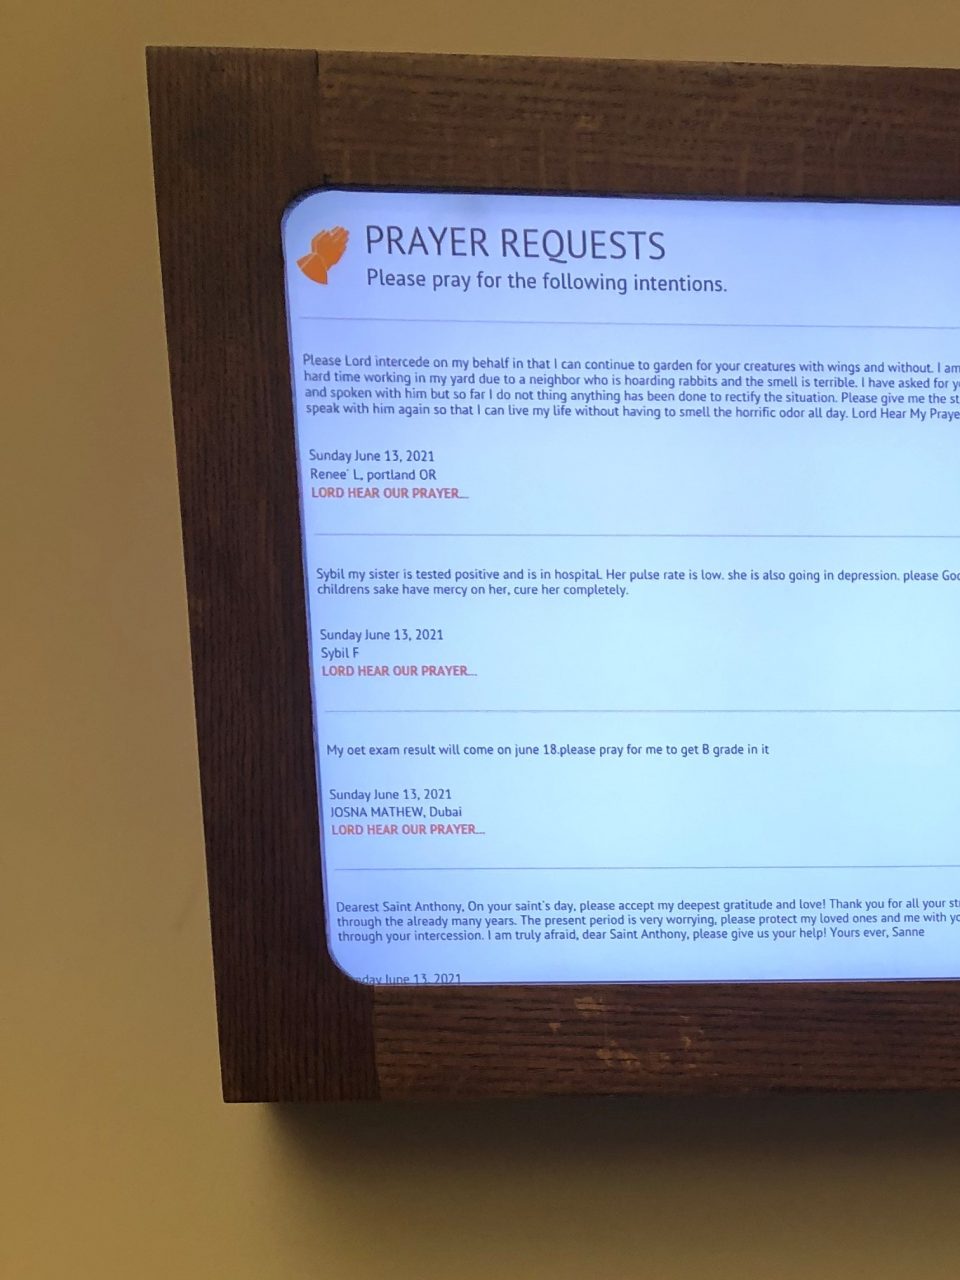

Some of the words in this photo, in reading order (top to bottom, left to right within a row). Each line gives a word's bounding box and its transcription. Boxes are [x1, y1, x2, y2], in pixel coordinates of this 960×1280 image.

[366, 224, 489, 257] PRAYER
[501, 228, 665, 263] REQUESTS
[366, 268, 426, 286] Please
[432, 274, 471, 292] pray
[476, 270, 502, 288] for
[506, 271, 536, 289] the
[542, 271, 627, 295] following
[633, 273, 727, 292] intentions.
[302, 355, 342, 368] Please
[344, 355, 372, 366] Lord
[375, 356, 430, 367] intercede
[432, 358, 448, 368] on
[451, 359, 469, 371] my
[472, 357, 510, 369] behalf
[512, 357, 524, 369] in
[526, 357, 551, 369] that
[554, 357, 558, 369] I
[560, 360, 581, 369] can
[584, 358, 635, 370] continue
[637, 360, 650, 370] to
[652, 359, 693, 374] garden
[696, 359, 713, 371] for
[714, 362, 741, 374] your
[743, 361, 796, 372] creatures
[798, 360, 824, 372] with
[826, 360, 861, 376] wings
[863, 361, 885, 373] and
[886, 361, 934, 373] without.
[937, 361, 941, 373] I
[309, 449, 352, 464] Sunday
[353, 449, 380, 461] June
[384, 449, 403, 463] 13,
[405, 449, 435, 462] 2021
[366, 468, 416, 483] portland
[418, 468, 438, 480] OR
[311, 486, 344, 498] LORD
[347, 486, 380, 498] HEAR
[383, 487, 409, 499] OUR
[316, 583, 370, 595] childrens
[372, 583, 400, 594] sake
[401, 583, 430, 594] have
[432, 586, 468, 597] mercy
[470, 586, 486, 594] on
[488, 583, 511, 596] her,
[512, 586, 539, 595] cure
[540, 584, 560, 595] her
[562, 584, 629, 598] completely.
[319, 628, 363, 643] Sunday
[364, 628, 391, 640] June
[393, 628, 412, 641] 13,
[415, 628, 444, 640] 2021
[320, 646, 350, 661] Sybil
[352, 646, 359, 658] F
[322, 665, 354, 676] LORD
[358, 665, 389, 676] HEAR
[392, 665, 418, 676] OUR
[326, 744, 344, 758] My
[346, 745, 366, 755] oet
[368, 746, 400, 755] exam
[403, 744, 436, 755] result
[438, 744, 460, 755] will
[463, 746, 494, 755] come
[496, 746, 511, 755] on
[514, 743, 539, 758] june
[599, 746, 624, 758] pray
[626, 743, 642, 755] for
[645, 746, 663, 755] me
[665, 745, 678, 755] to
[680, 744, 699, 758] get
[702, 743, 710, 755] B
[712, 743, 744, 758] grade
[747, 743, 758, 754] in
[761, 743, 769, 754] it
[329, 788, 371, 803] Sunday
[373, 788, 399, 800] June
[402, 788, 420, 801] 13,
[423, 788, 451, 800] 2021
[330, 806, 368, 817] JOSNA
[370, 806, 427, 818] MATHEW,
[428, 805, 462, 817] Dubai
[331, 824, 364, 835] LORD
[366, 824, 398, 835] HEAR
[401, 824, 427, 835] OUR
[336, 901, 379, 914] Dearest
[382, 901, 412, 913] Saint
[414, 901, 465, 917] Anthony,
[467, 900, 484, 911] On
[486, 903, 512, 914] your
[514, 900, 551, 913] saint's
[553, 900, 577, 913] day,
[579, 900, 615, 916] please
[618, 900, 655, 915] accept
[657, 902, 675, 913] my
[676, 899, 720, 915] deepest
[722, 898, 773, 915] gratitude
[775, 898, 796, 909] and
[798, 898, 826, 911] love!
[828, 898, 862, 911] Thank
[864, 900, 885, 911] you
[887, 898, 903, 910] for
[905, 897, 920, 908] all
[922, 900, 946, 913] your
[434, 973, 461, 984] 2021
